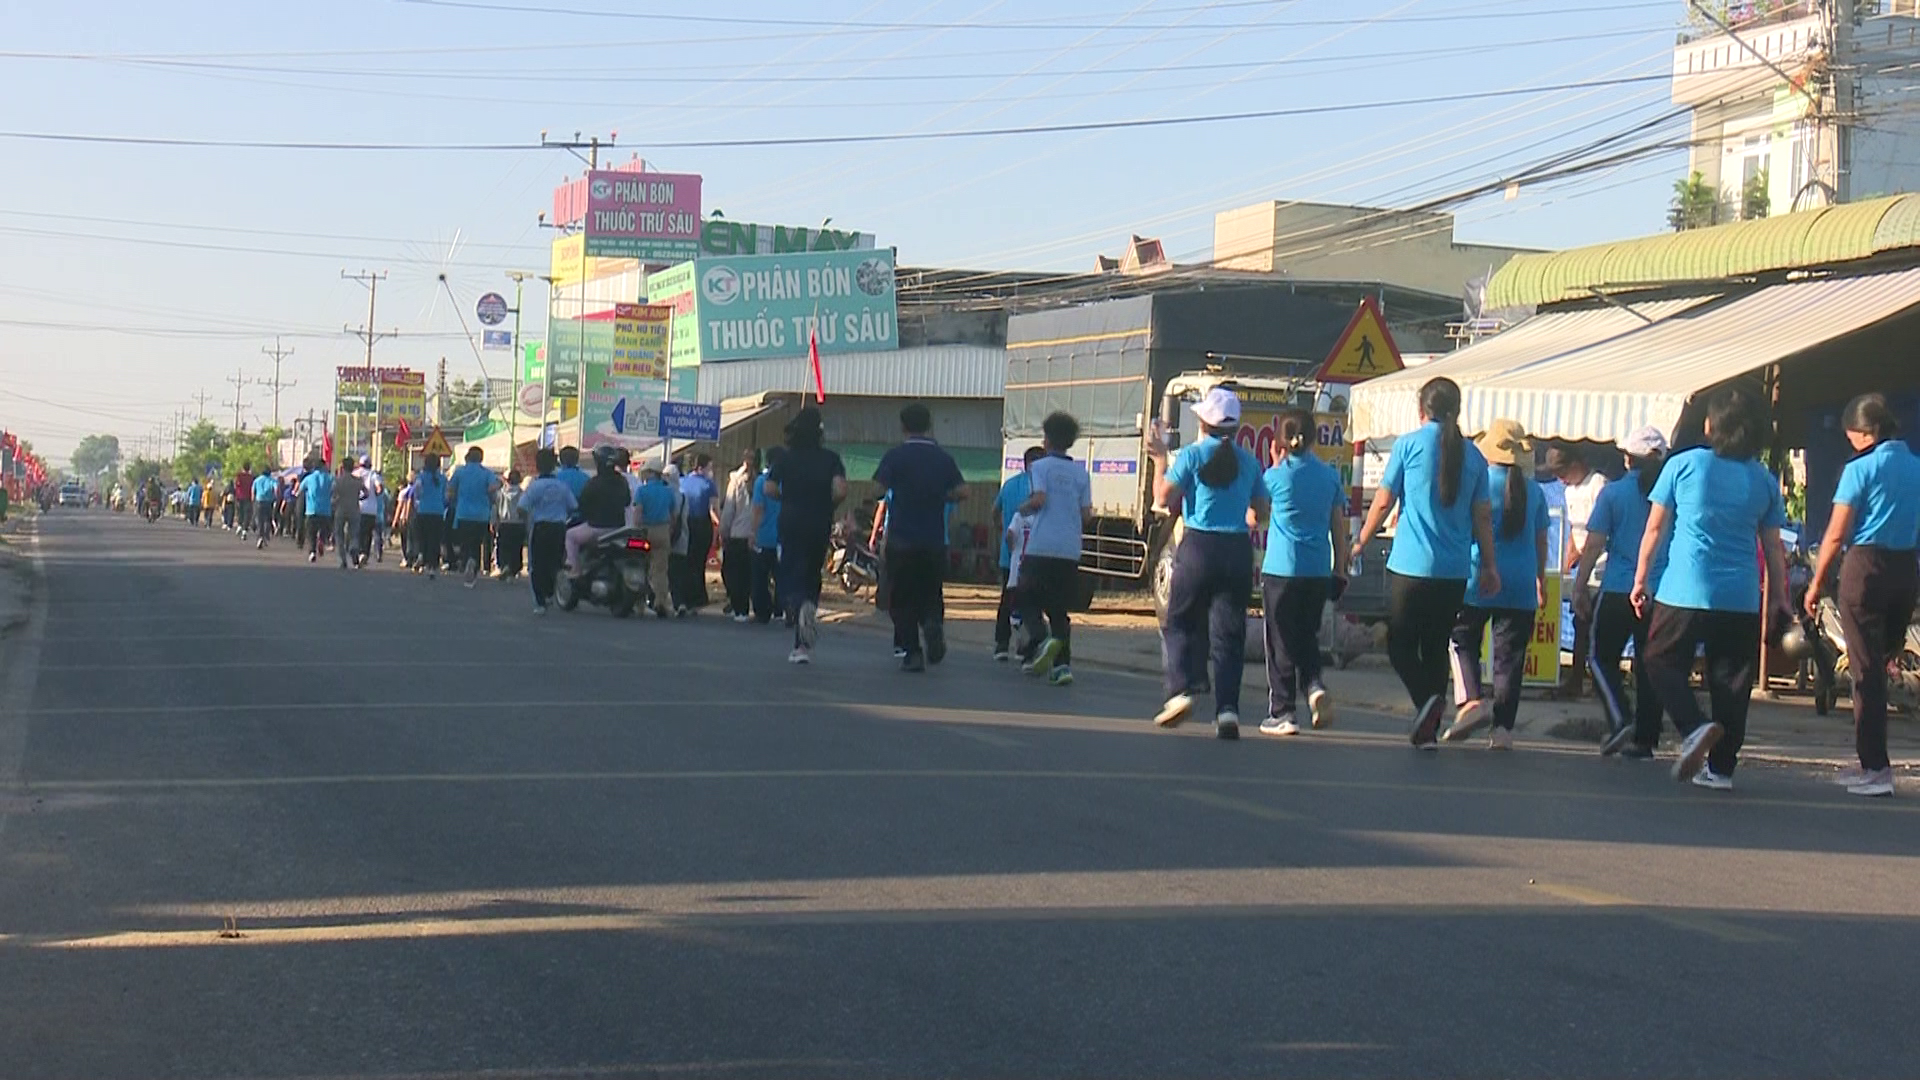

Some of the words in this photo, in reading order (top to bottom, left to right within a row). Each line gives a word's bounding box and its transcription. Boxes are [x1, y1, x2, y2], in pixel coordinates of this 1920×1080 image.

[615, 177, 647, 203] PHÂN
[651, 178, 674, 205] BÓN
[594, 204, 636, 232] THUỐC
[640, 209, 666, 233] TRỪ
[668, 209, 694, 234] SÂU
[774, 218, 861, 253] MÁY
[708, 277, 738, 293] KT
[742, 264, 800, 300] PHÂN
[807, 260, 851, 298] BÓN
[632, 306, 649, 317] KIM
[649, 307, 669, 318] ANH
[708, 307, 785, 350] THUỐC
[792, 309, 839, 346] TRỪ
[844, 306, 891, 343] SÂU
[664, 415, 698, 427] TRƯỜNG
[699, 419, 717, 430] HỌC
[673, 405, 691, 415] KHU
[693, 406, 710, 417] VỰC
[1317, 420, 1344, 446] GÀ
